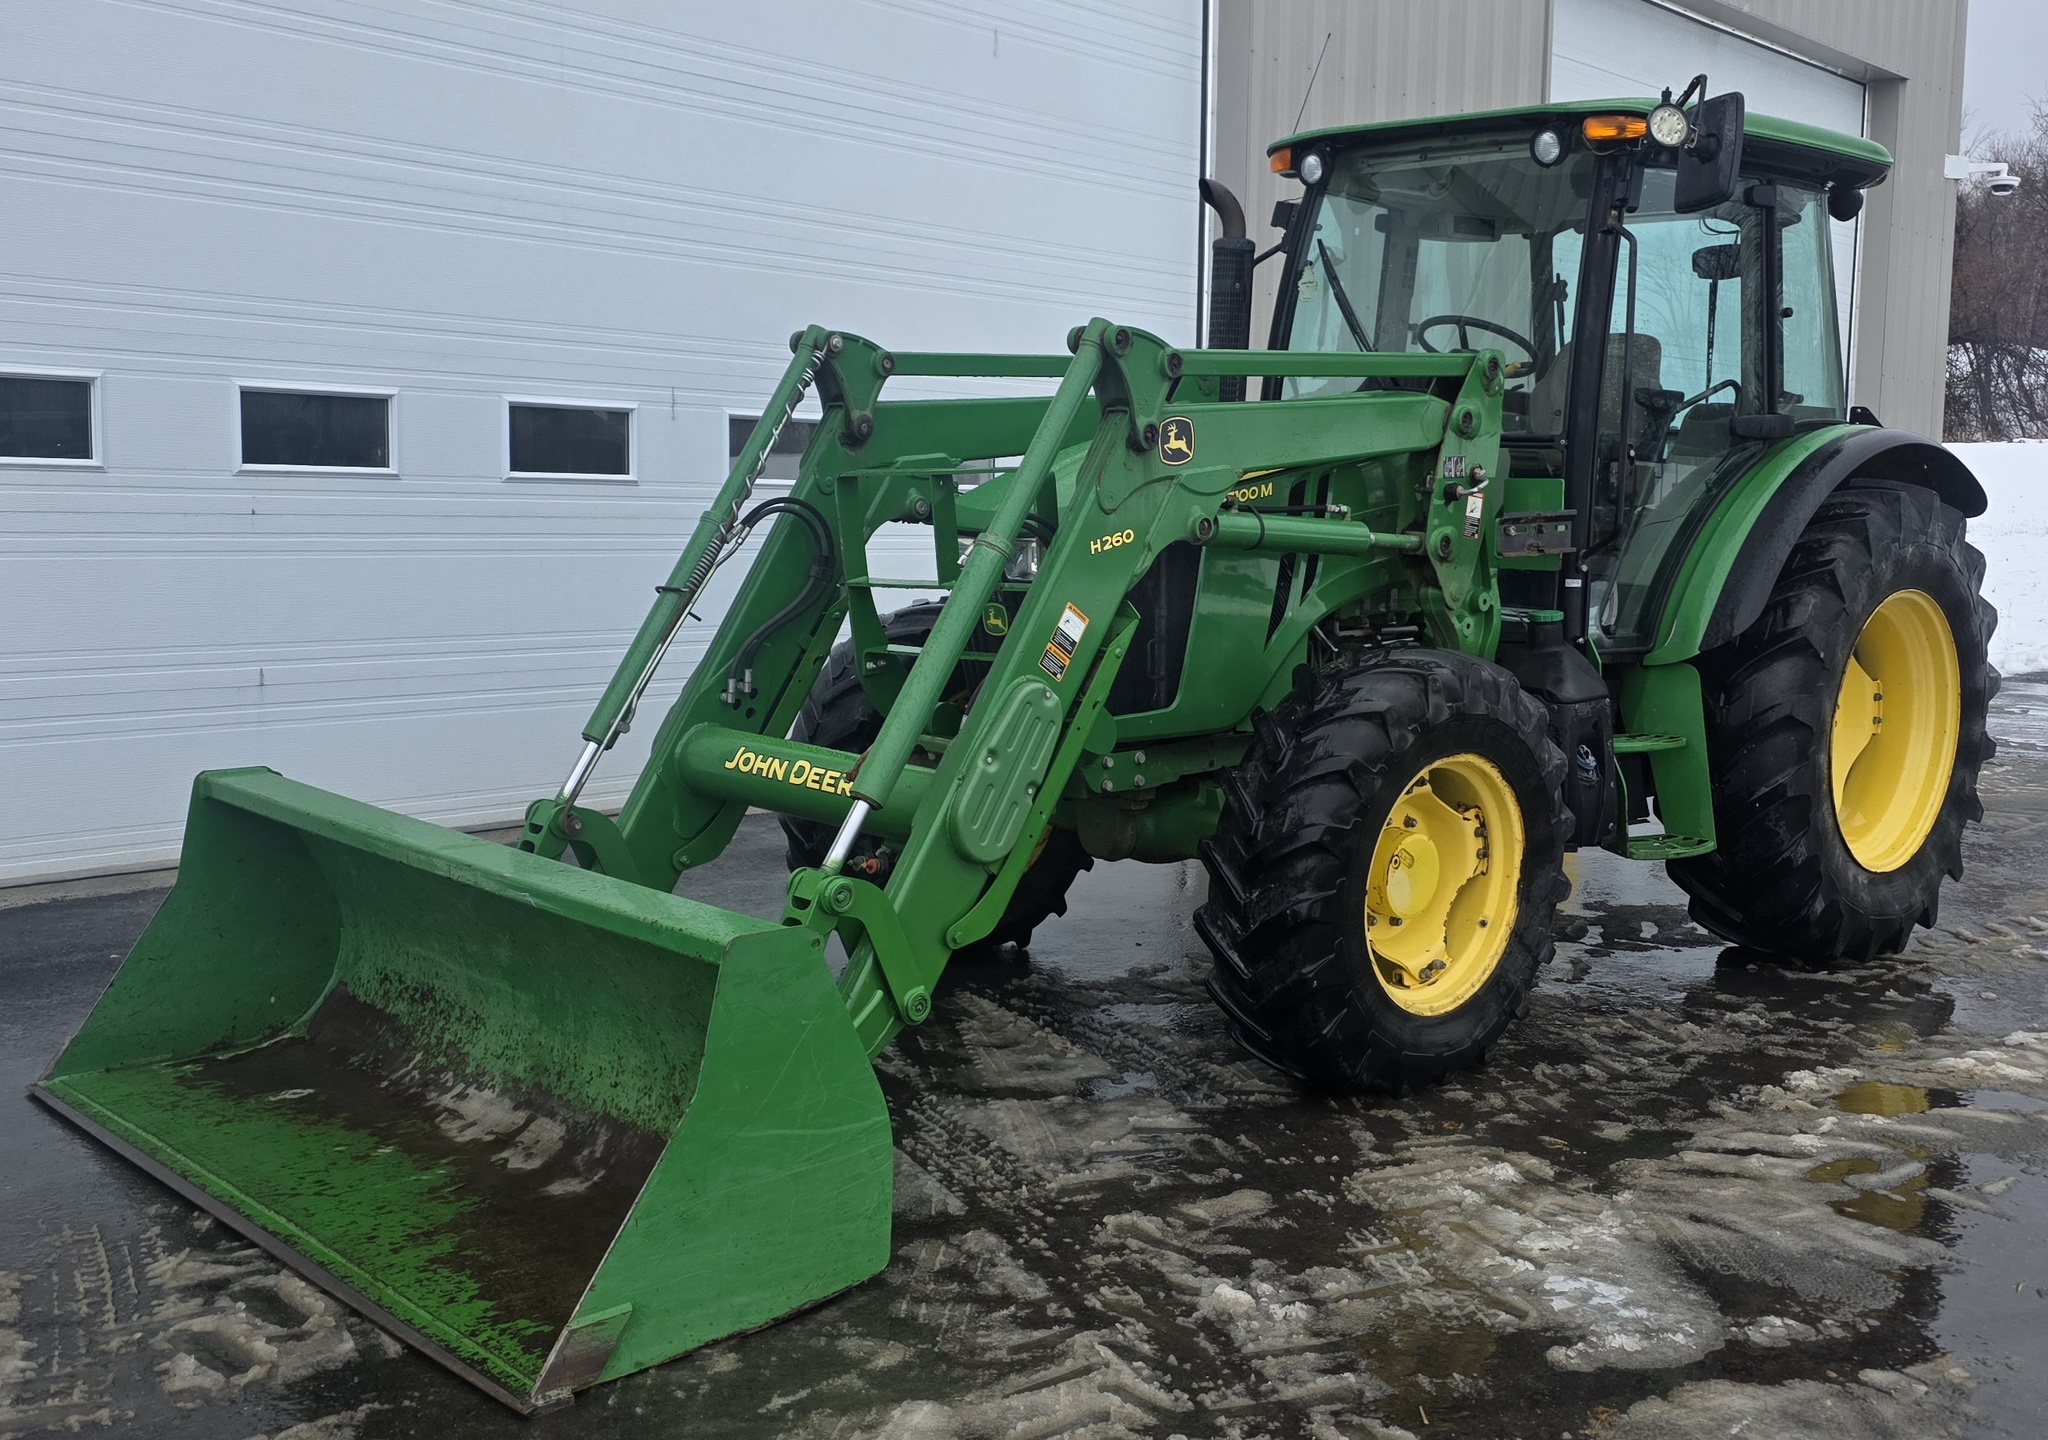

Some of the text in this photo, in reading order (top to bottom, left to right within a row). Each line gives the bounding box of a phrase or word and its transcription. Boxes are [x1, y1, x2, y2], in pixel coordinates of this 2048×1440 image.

[1090, 528, 1135, 555] H260
[724, 746, 854, 797] JOHN DEER
